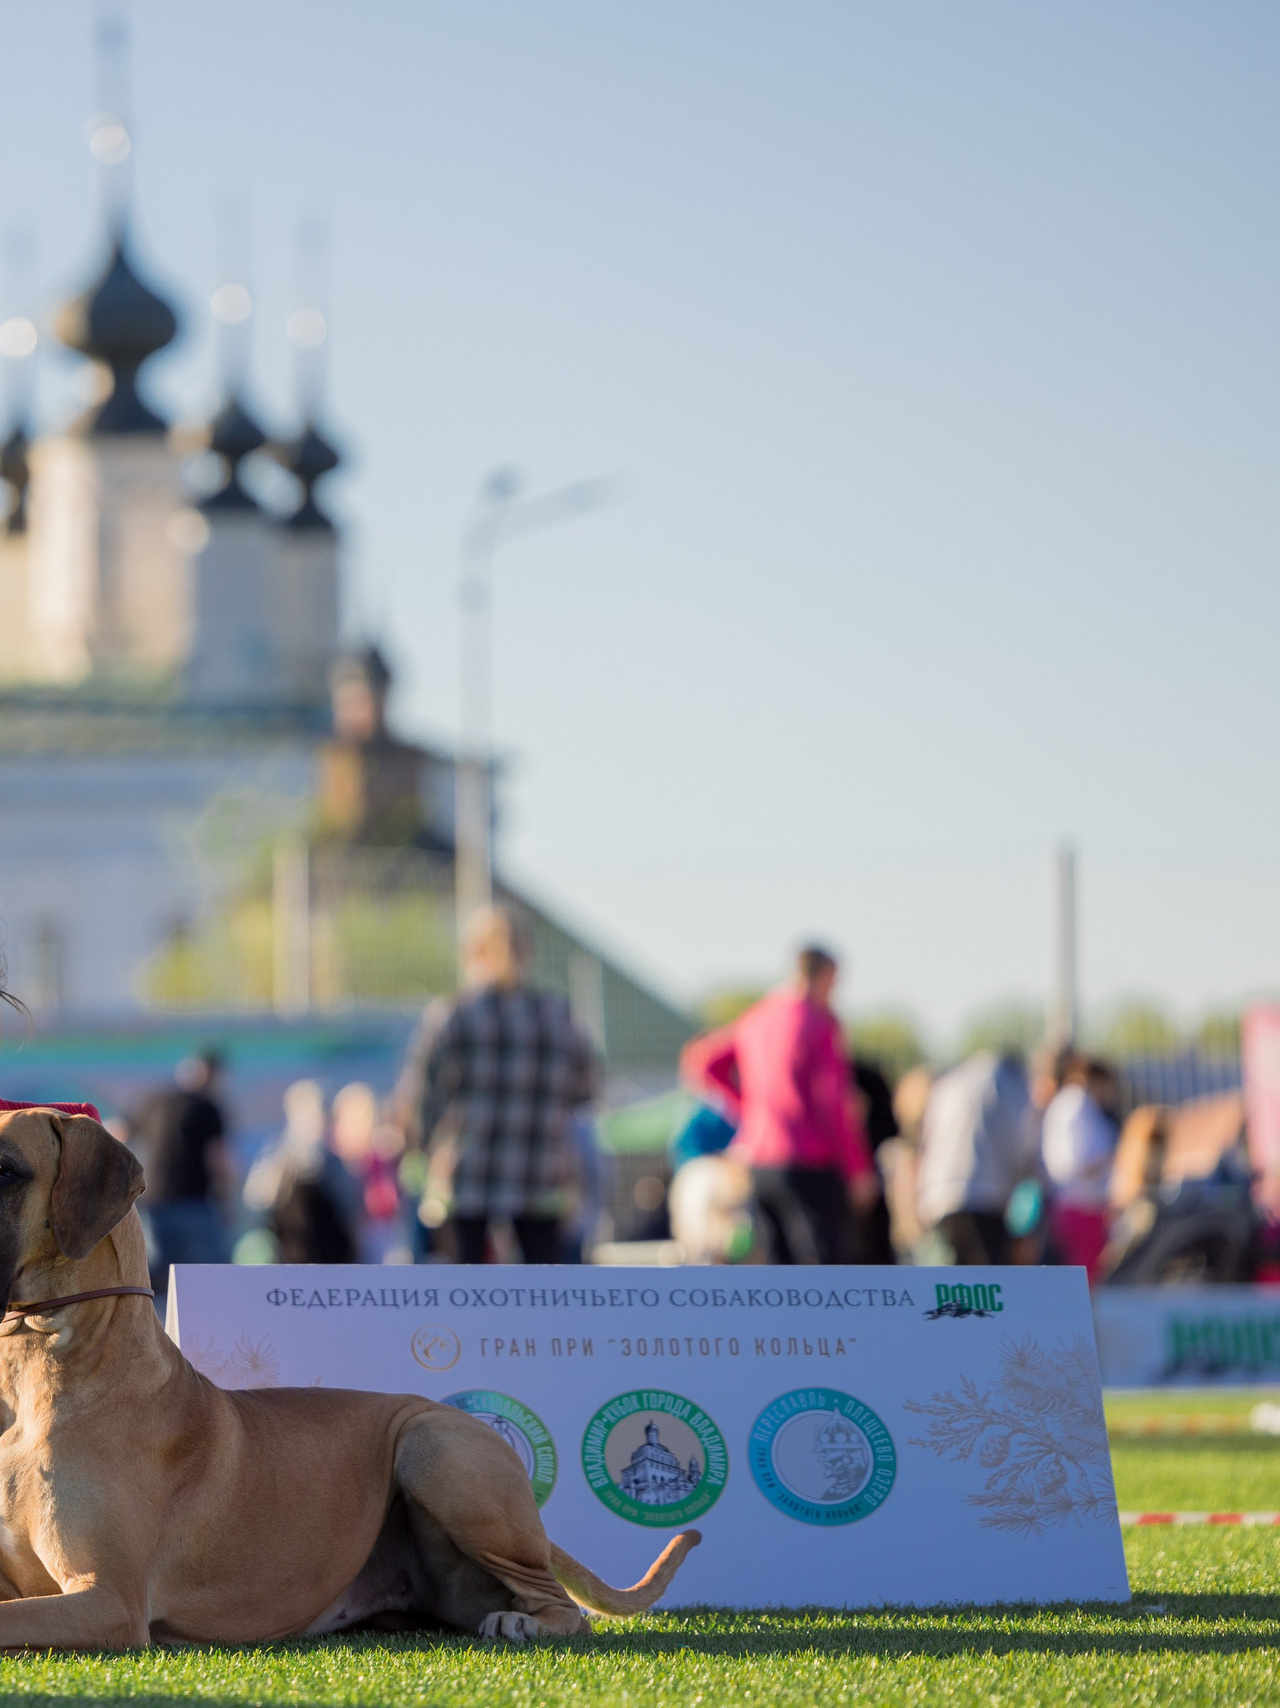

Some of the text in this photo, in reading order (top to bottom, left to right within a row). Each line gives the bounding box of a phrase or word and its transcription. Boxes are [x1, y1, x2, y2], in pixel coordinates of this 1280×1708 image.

[266, 1287, 917, 1310] ФЕДЕРАЦИЯ ОХОТНИЧЬЕГО СОБАКОВОДСТВА
[480, 1337, 537, 1357] ГРАН
[551, 1337, 594, 1356] ПРИ
[642, 1392, 693, 1419] ГОРОДА
[689, 1412, 727, 1486] ВЛАДИМИРА
[753, 1391, 826, 1443] ПЕРЕСЛАВЛЬ
[535, 1446, 555, 1484] СОКОЛ
[844, 1400, 893, 1506] ПЛЕЩЕЕВО ОЗЕРО
